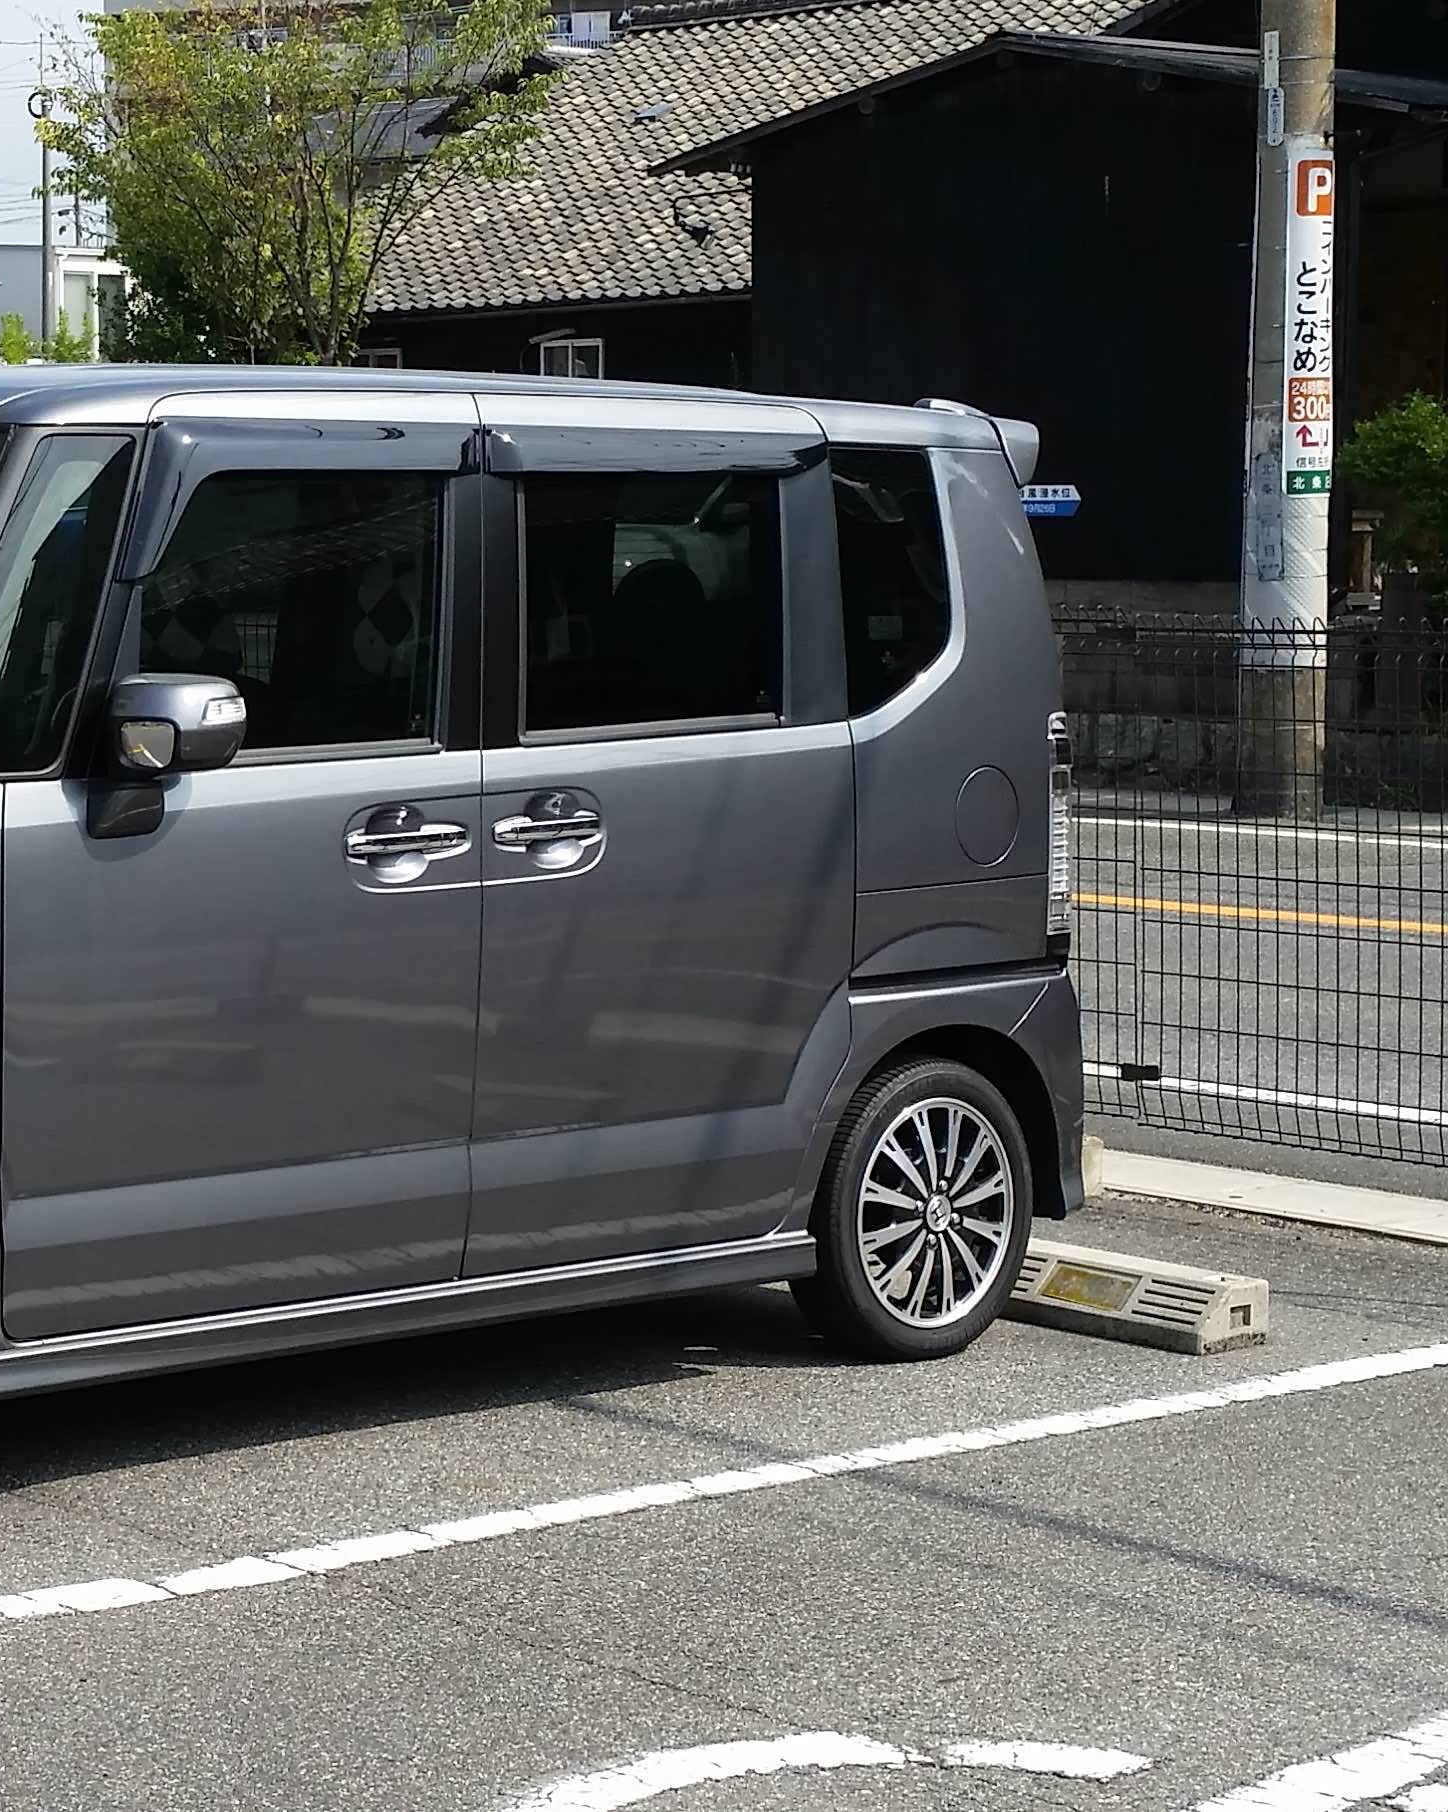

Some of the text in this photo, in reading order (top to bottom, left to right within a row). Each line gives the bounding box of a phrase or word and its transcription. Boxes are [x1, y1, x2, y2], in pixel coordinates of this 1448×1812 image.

[1307, 167, 1331, 213] P
[1293, 261, 1317, 372] とこなめ
